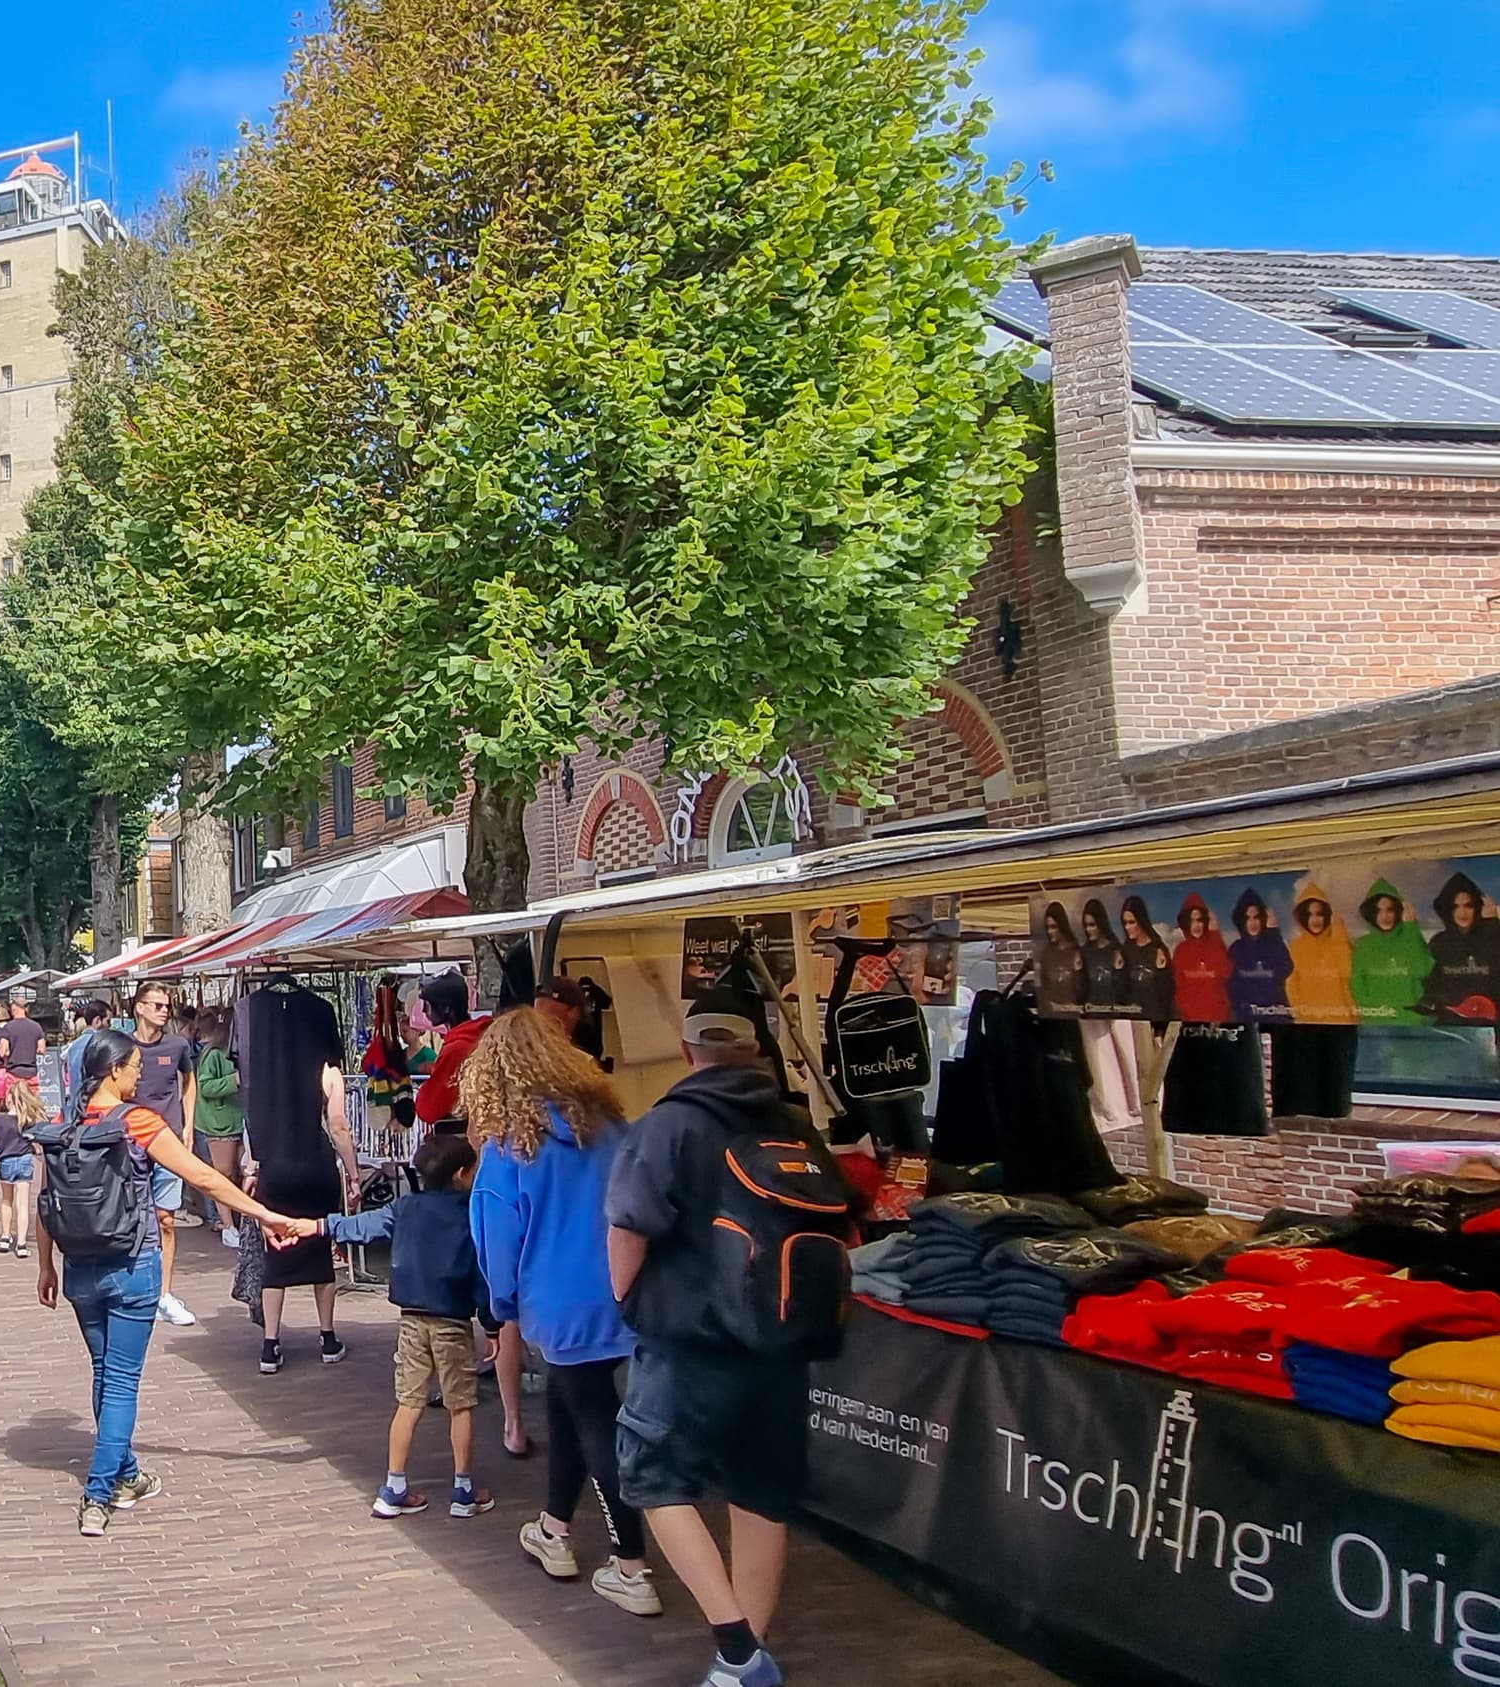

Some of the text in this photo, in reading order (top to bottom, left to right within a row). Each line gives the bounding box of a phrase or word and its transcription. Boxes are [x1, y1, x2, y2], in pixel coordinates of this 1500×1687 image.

[711, 938, 728, 953] wat
[823, 1416, 846, 1438] van
[867, 1405, 895, 1426] aan
[899, 1413, 920, 1433] en
[924, 1419, 949, 1444] van
